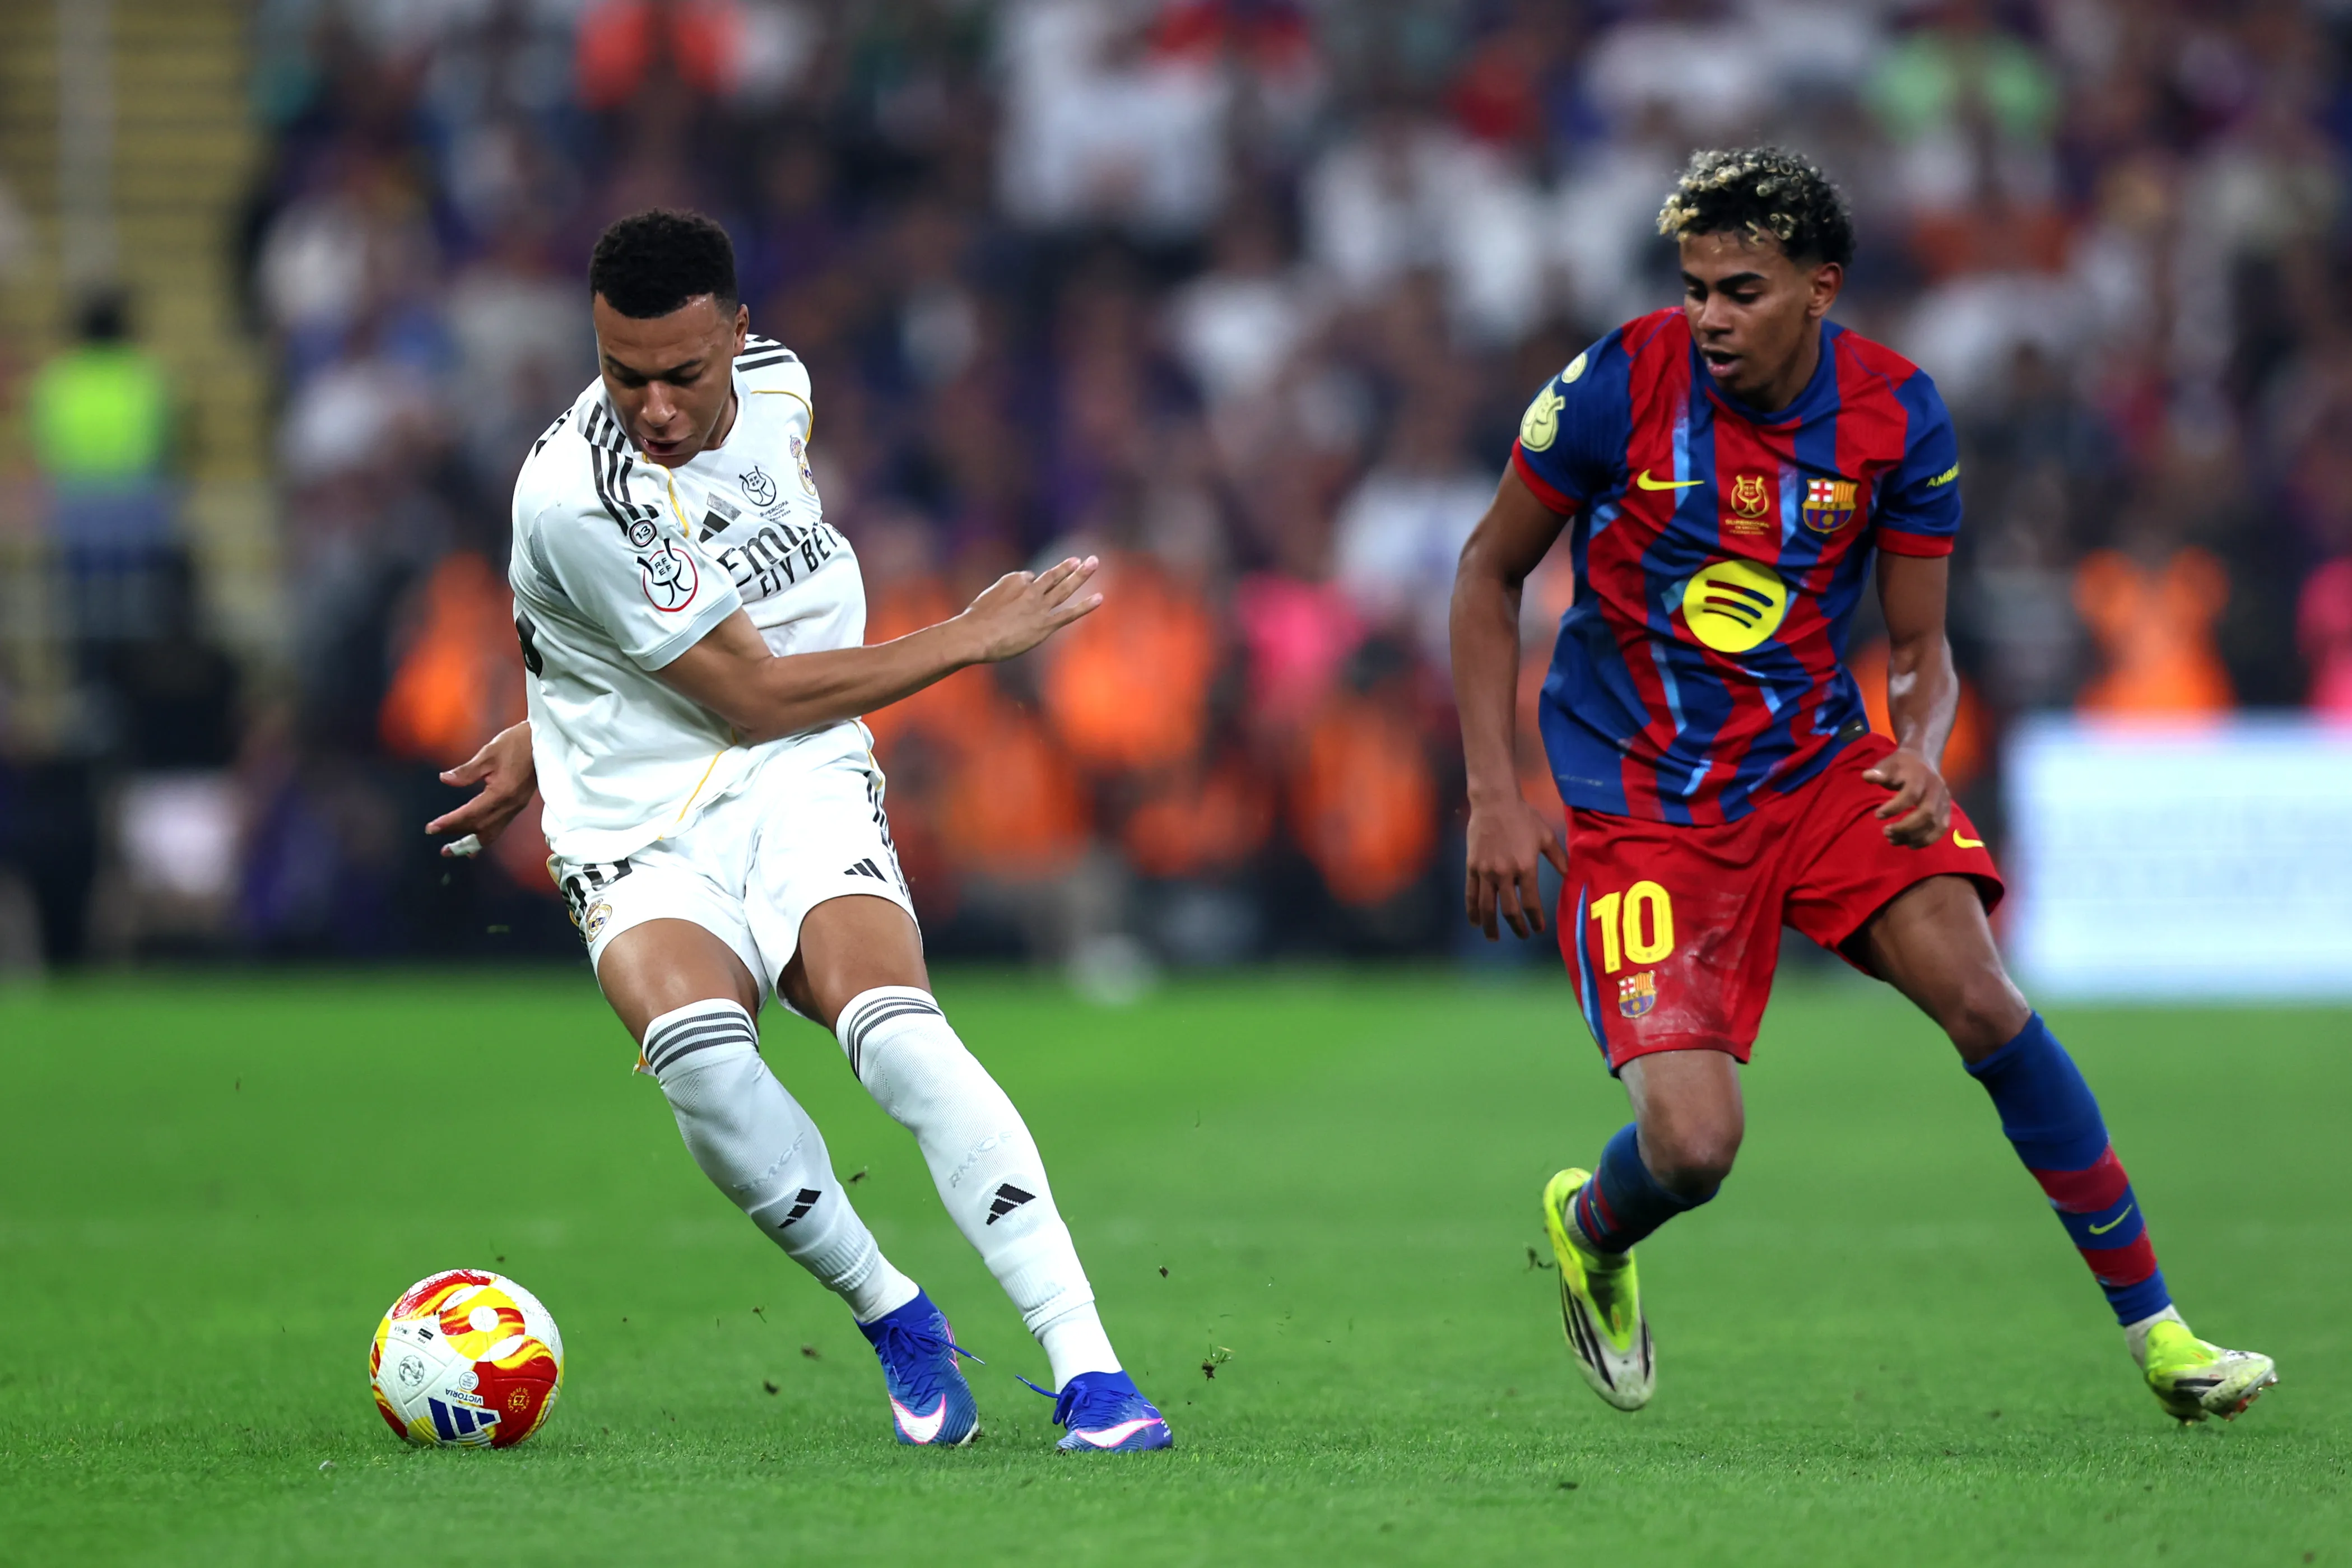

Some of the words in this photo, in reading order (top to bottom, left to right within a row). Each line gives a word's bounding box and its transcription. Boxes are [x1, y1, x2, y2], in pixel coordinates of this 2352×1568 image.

[636, 525, 650, 539] 13
[654, 557, 667, 569] RF
[658, 565, 672, 576] EF
[1591, 880, 1675, 974] 10
[445, 1389, 482, 1403] VICTORIA
